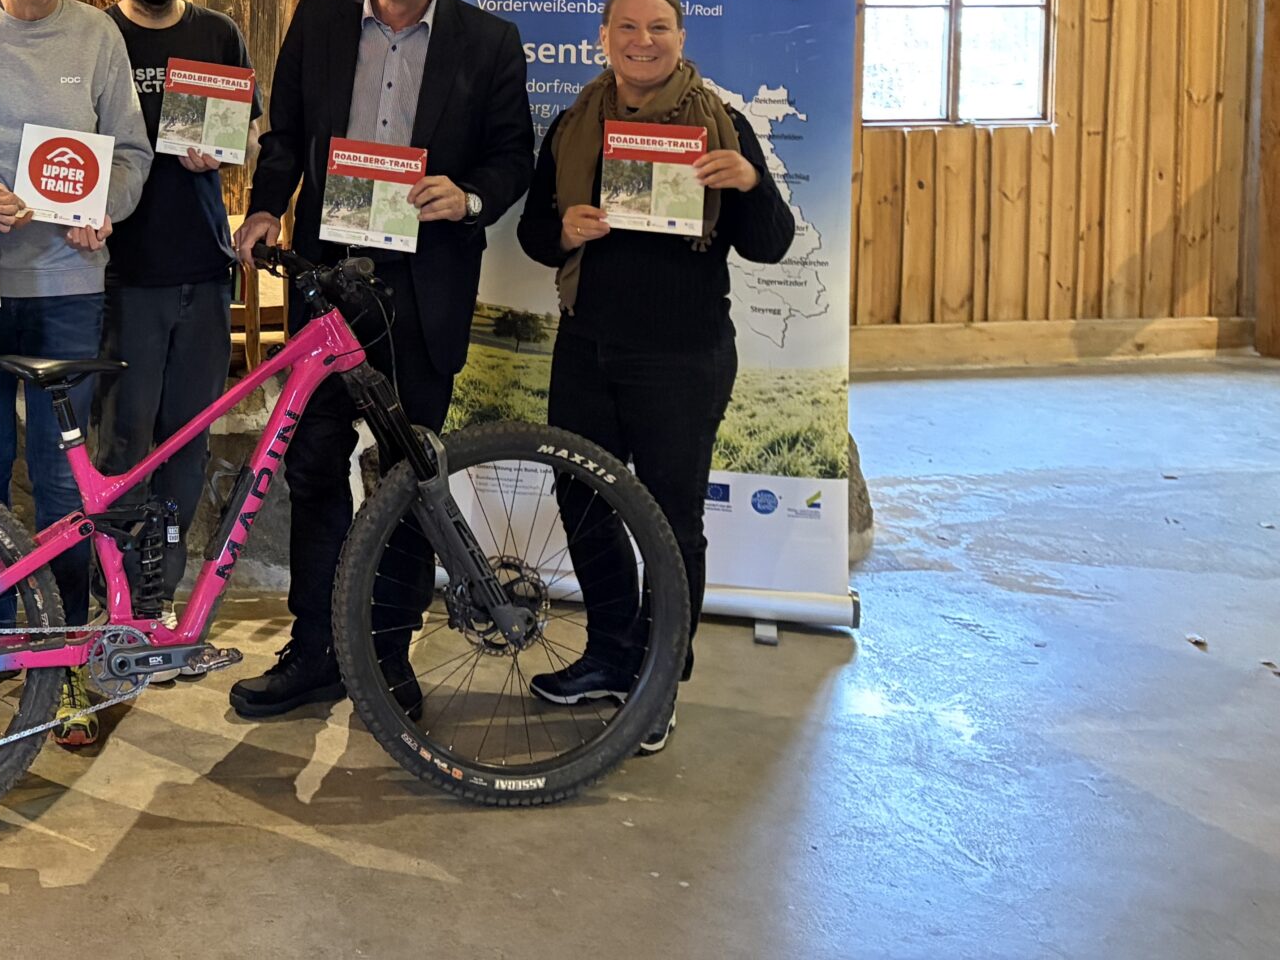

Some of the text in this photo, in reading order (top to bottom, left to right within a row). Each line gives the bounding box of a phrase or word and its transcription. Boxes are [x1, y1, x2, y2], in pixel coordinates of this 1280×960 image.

[171, 71, 249, 89] ROADLBERG-TRAILS
[609, 135, 700, 150] ROADLBERG-TRAILS
[334, 152, 420, 170] ROADLBERG-TRAILS
[42, 164, 85, 182] UPPER
[40, 177, 83, 196] TRAILS
[536, 444, 617, 484] MAXXIS
